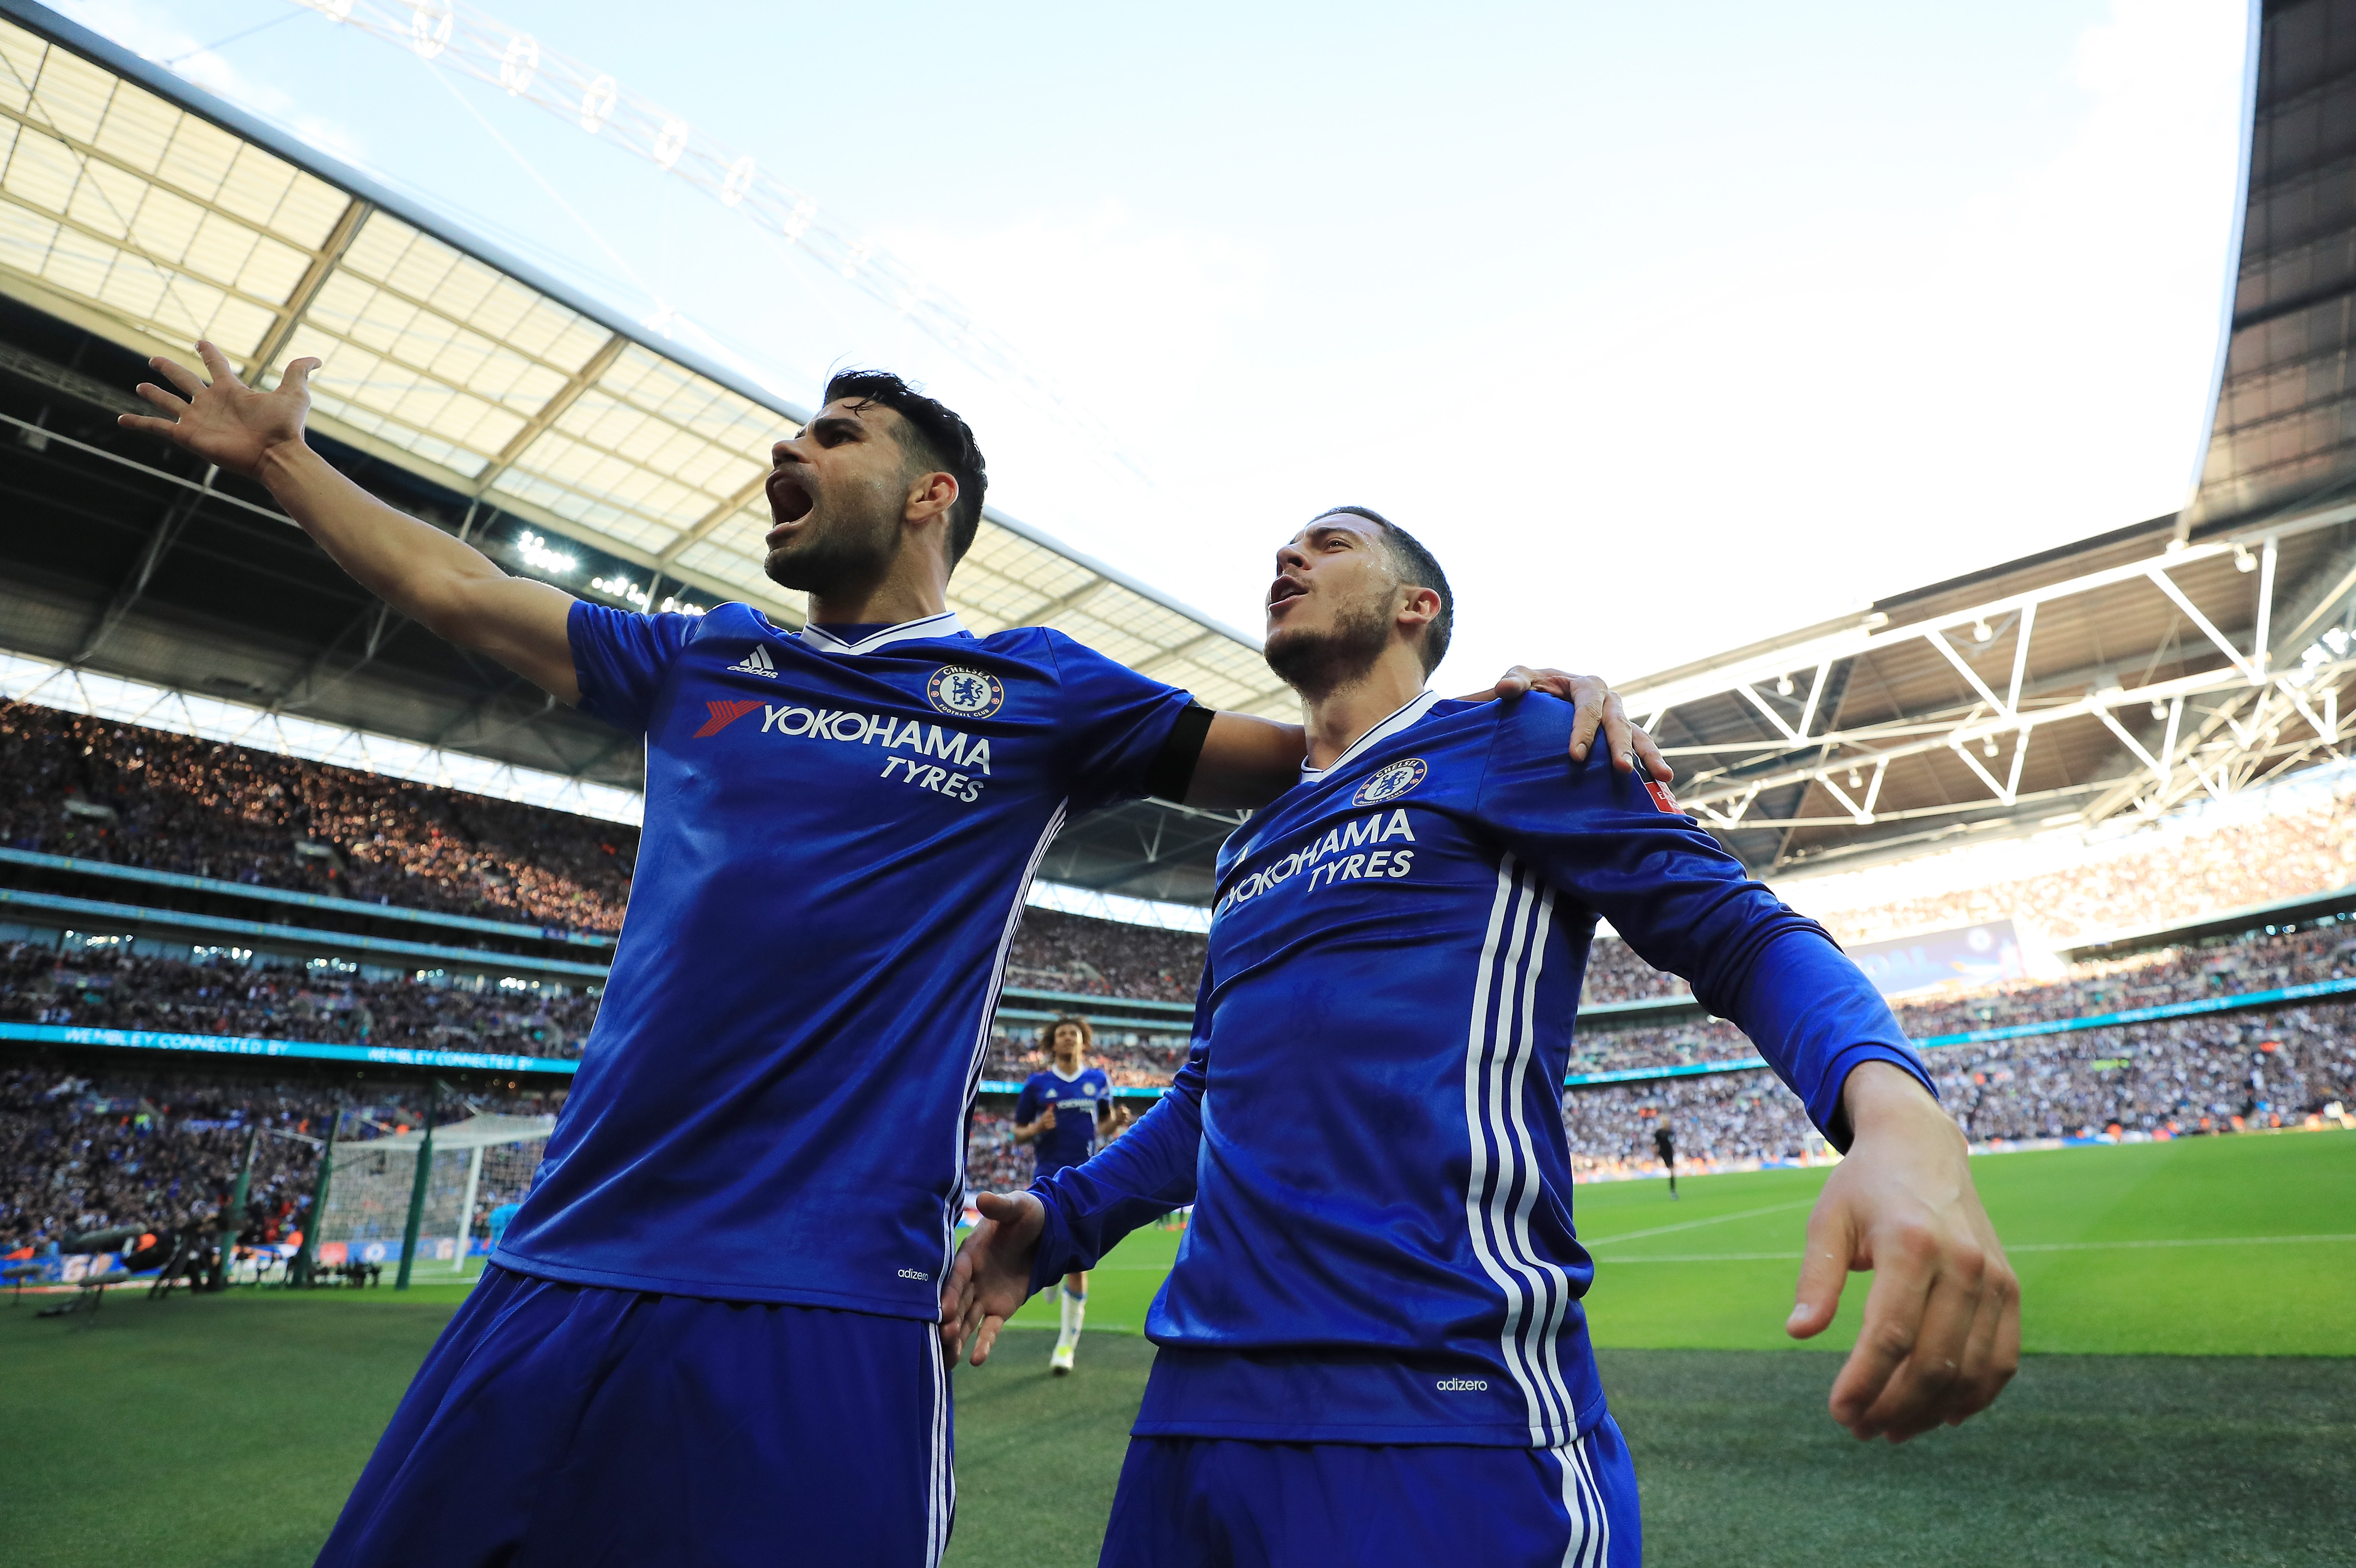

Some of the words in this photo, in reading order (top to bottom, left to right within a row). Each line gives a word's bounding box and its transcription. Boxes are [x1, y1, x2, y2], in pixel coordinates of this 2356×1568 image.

[727, 665, 778, 679] adidas
[942, 666, 991, 681] CHELSEA
[939, 703, 971, 717] FOOTBALL
[973, 708, 990, 717] CLUB
[760, 705, 991, 776] YOKOHAMA
[1375, 760, 1420, 778] CHELSEA
[880, 755, 984, 803] TYRES
[1386, 789, 1404, 799] CLUB
[1224, 808, 1416, 911] YOKOHAMA
[1307, 849, 1415, 893] TYRES
[65, 1027, 155, 1047] WEMBLEY
[158, 1034, 262, 1054] CONNECTED
[267, 1040, 288, 1056] BY
[897, 1268, 928, 1282] adizero
[1436, 1377, 1488, 1391] adizero
